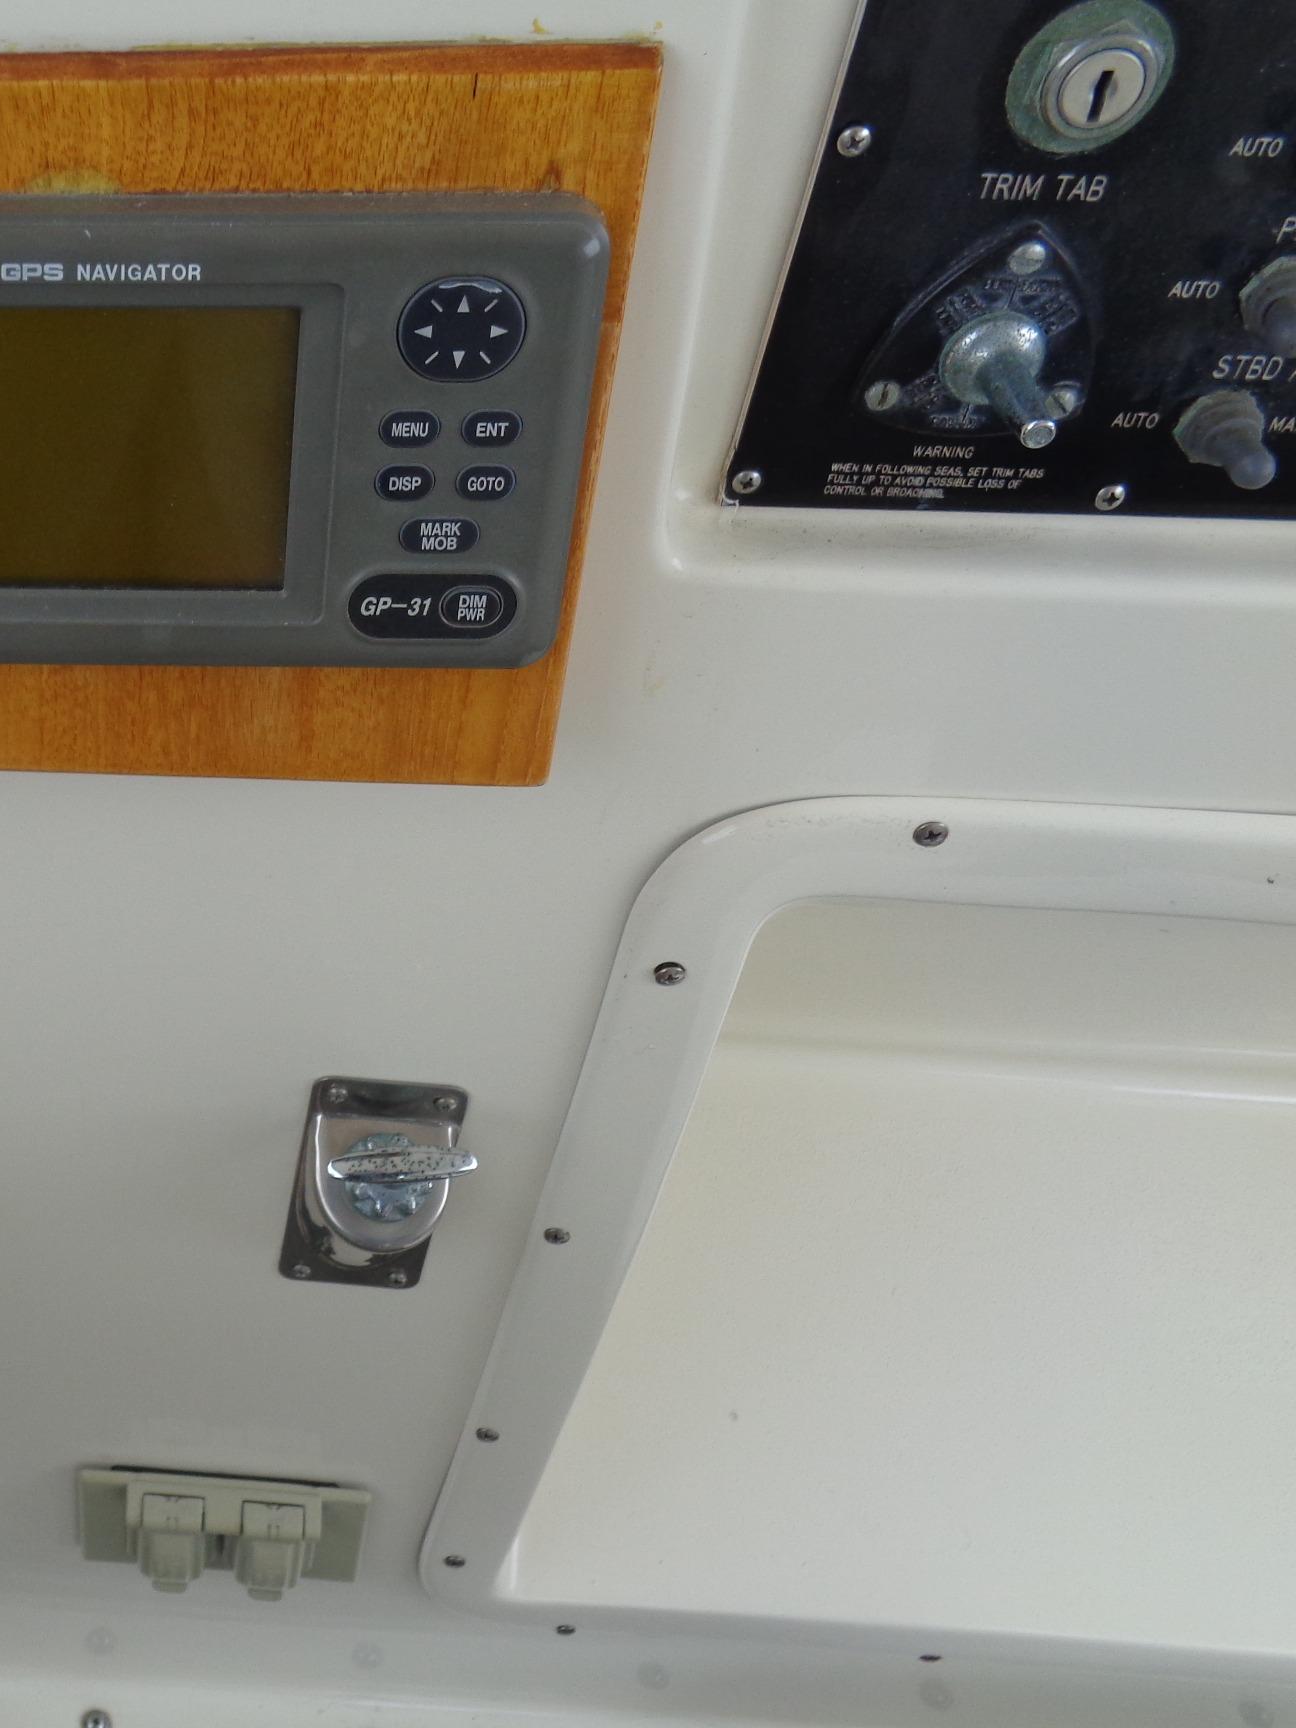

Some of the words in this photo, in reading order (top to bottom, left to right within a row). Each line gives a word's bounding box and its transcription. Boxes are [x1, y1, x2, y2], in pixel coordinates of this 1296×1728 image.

[1229, 137, 1284, 157] AUTO
[980, 172, 1045, 200] TRIM
[1056, 174, 1107, 201] TAB
[0, 263, 64, 281] GPS
[77, 263, 201, 282] NAVIGATOR
[1168, 281, 1221, 298] AUTO
[1212, 355, 1283, 380] STBD
[1111, 412, 1160, 429] AUTO
[1268, 416, 1296, 432] MA
[391, 422, 429, 438] MENU
[476, 422, 509, 437] ENT
[912, 445, 975, 459] WARNING
[831, 463, 859, 473] WHEN
[862, 463, 872, 473] IN
[875, 464, 932, 476] FOLLOWING
[967, 467, 986, 477] SET
[992, 468, 1014, 478] TRIM
[1018, 468, 1045, 479] TABS
[388, 477, 422, 492] DISP
[467, 477, 505, 492] GOTO
[827, 474, 858, 484] FULLY
[862, 475, 875, 484] UP
[879, 476, 892, 485] TO
[894, 476, 924, 487] AVOID
[926, 477, 975, 488] POSSIBLE
[978, 479, 1004, 489] LOSS
[1007, 479, 1022, 489] OF
[824, 485, 867, 496] CONTROL
[871, 486, 884, 496] OR
[420, 522, 461, 537] MARK
[421, 536, 457, 551] MOB
[360, 597, 432, 617] GP-31
[458, 595, 487, 609] DIM
[457, 608, 485, 621] PWR
